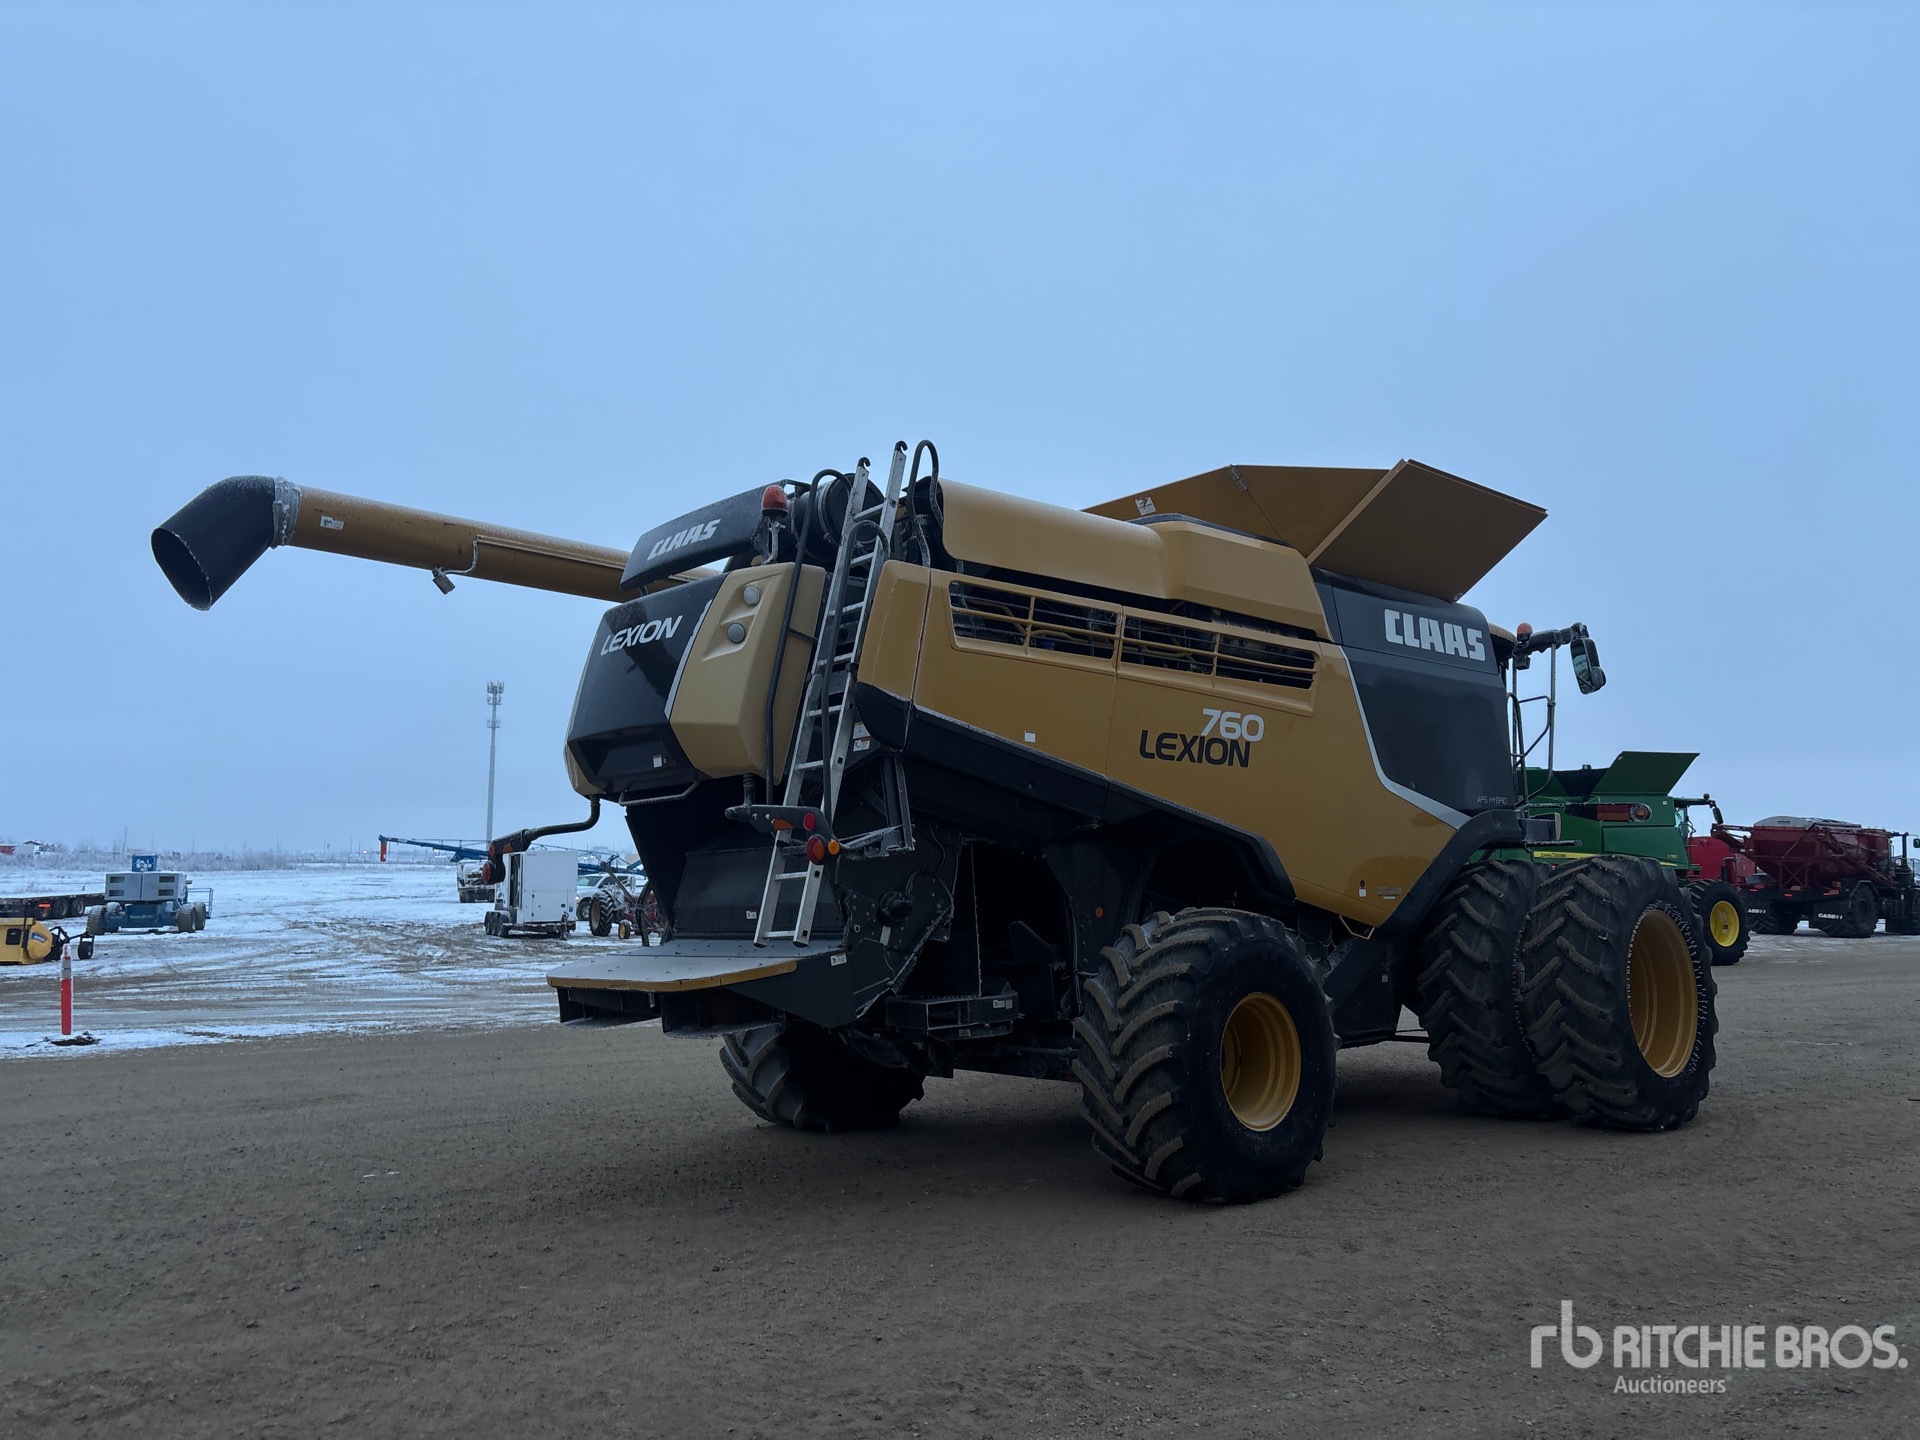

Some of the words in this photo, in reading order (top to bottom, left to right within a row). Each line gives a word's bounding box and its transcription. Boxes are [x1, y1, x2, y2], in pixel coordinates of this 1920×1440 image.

[646, 518, 722, 561] CLAAS
[600, 614, 683, 657] LEXION
[1383, 608, 1486, 662] CLAAS
[1200, 708, 1265, 742] 760
[1140, 729, 1251, 768] LEXION
[1477, 795, 1488, 804] APS
